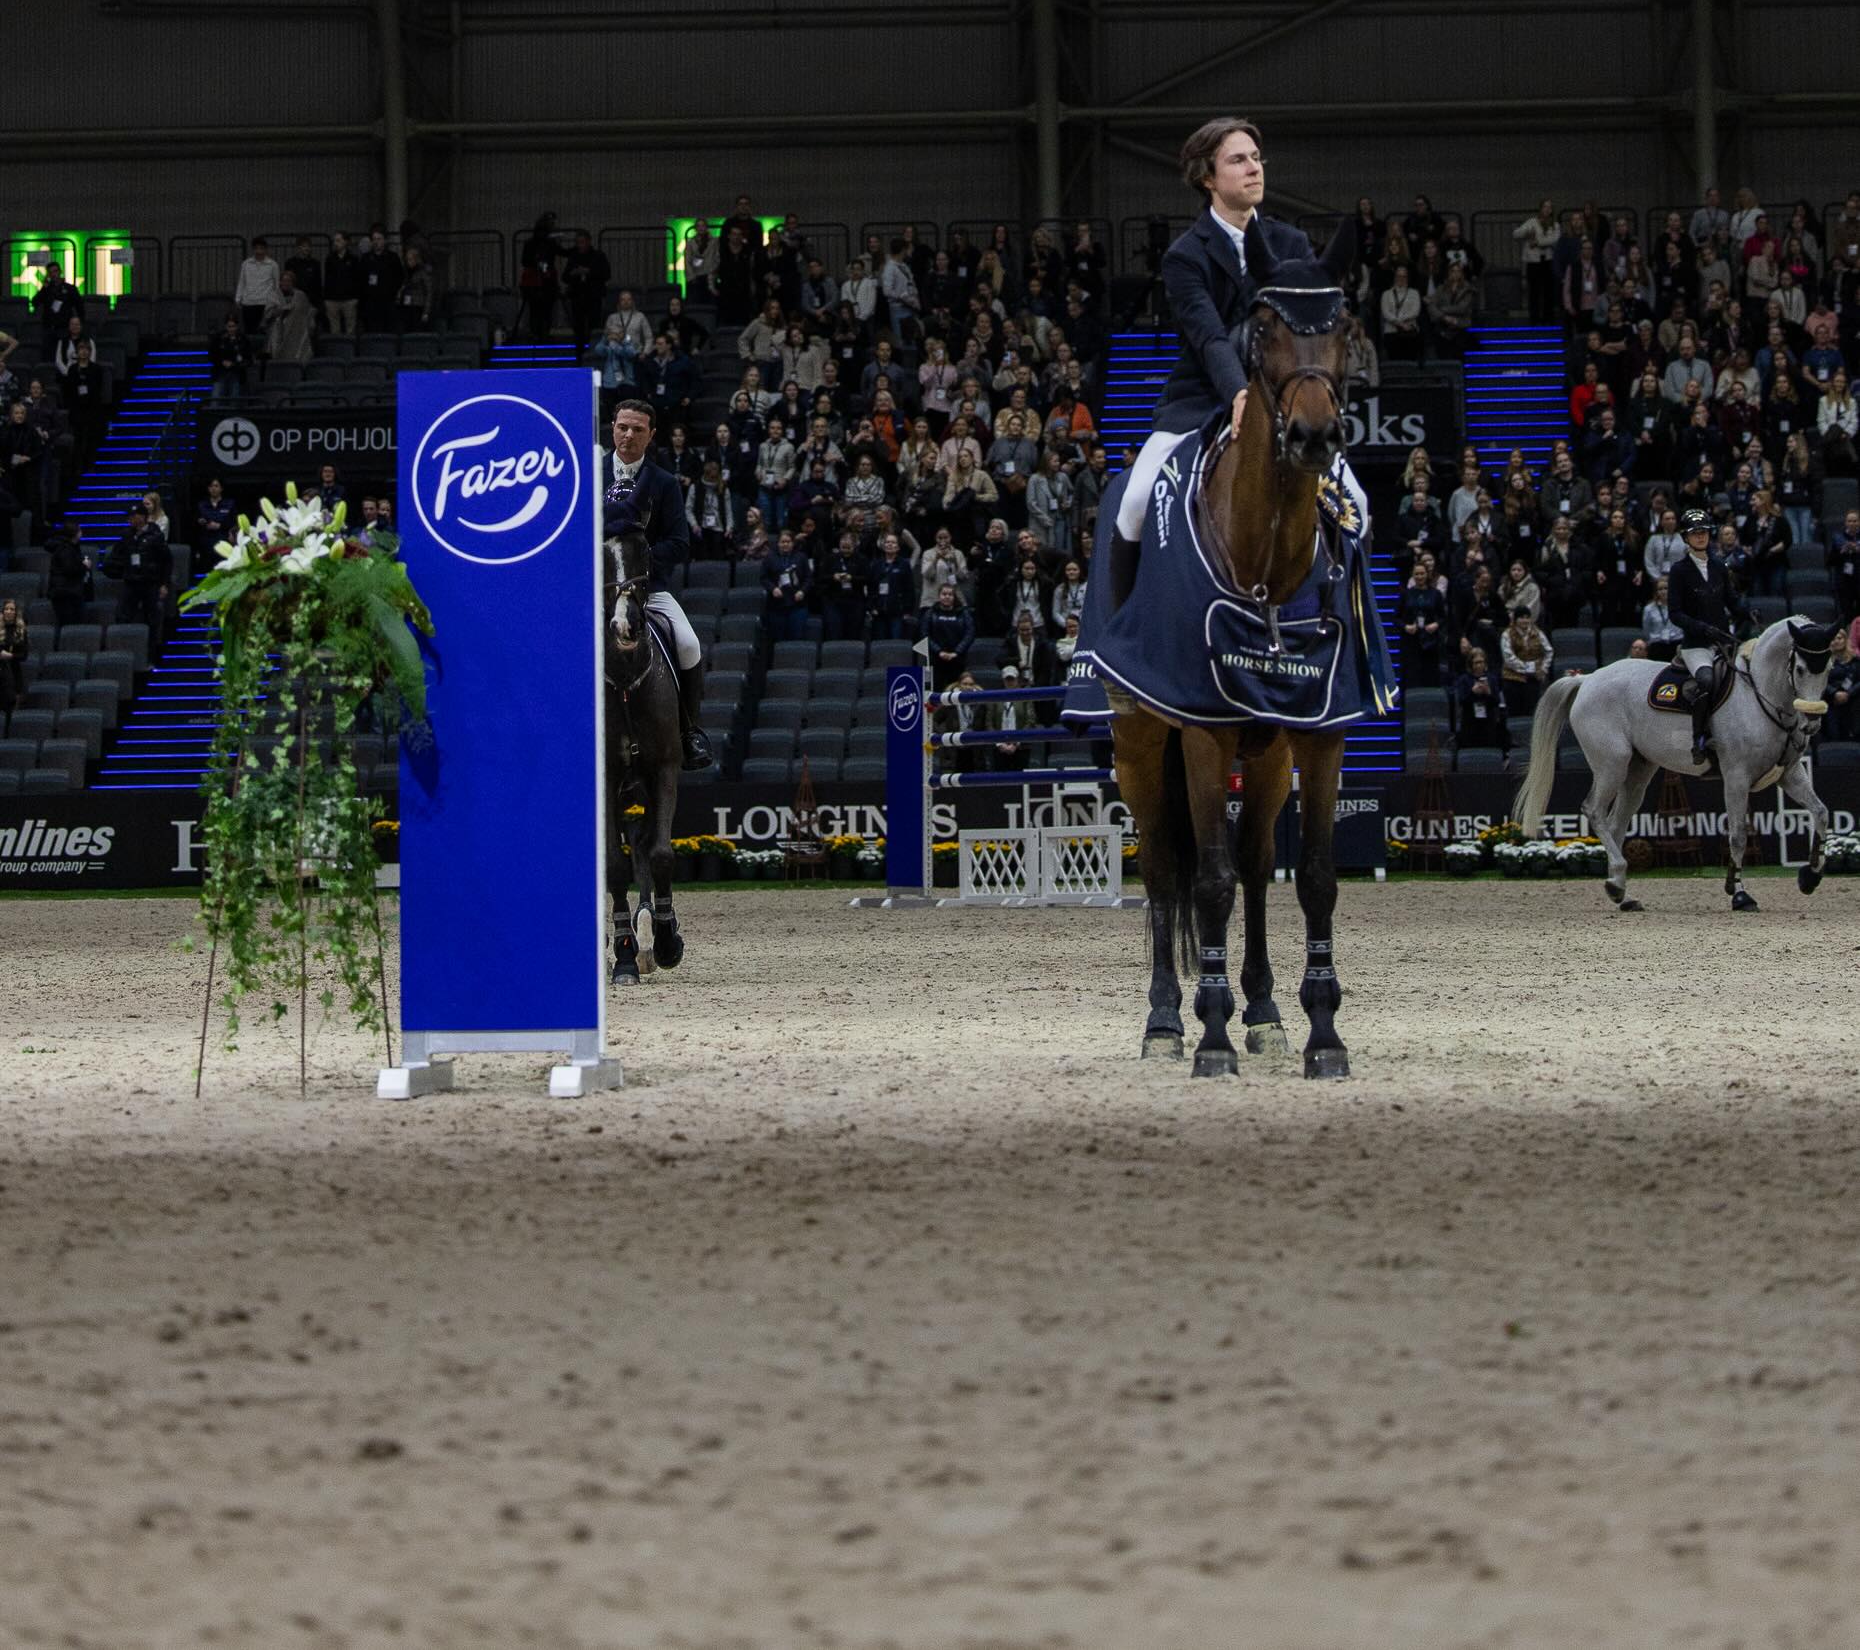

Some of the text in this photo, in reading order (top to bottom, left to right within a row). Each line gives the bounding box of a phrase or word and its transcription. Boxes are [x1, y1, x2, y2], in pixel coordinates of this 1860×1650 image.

[269, 428, 302, 452] OP
[432, 425, 565, 521] Fazer
[1222, 653, 1323, 679] HORSE SHOW
[31, 860, 87, 875] company
